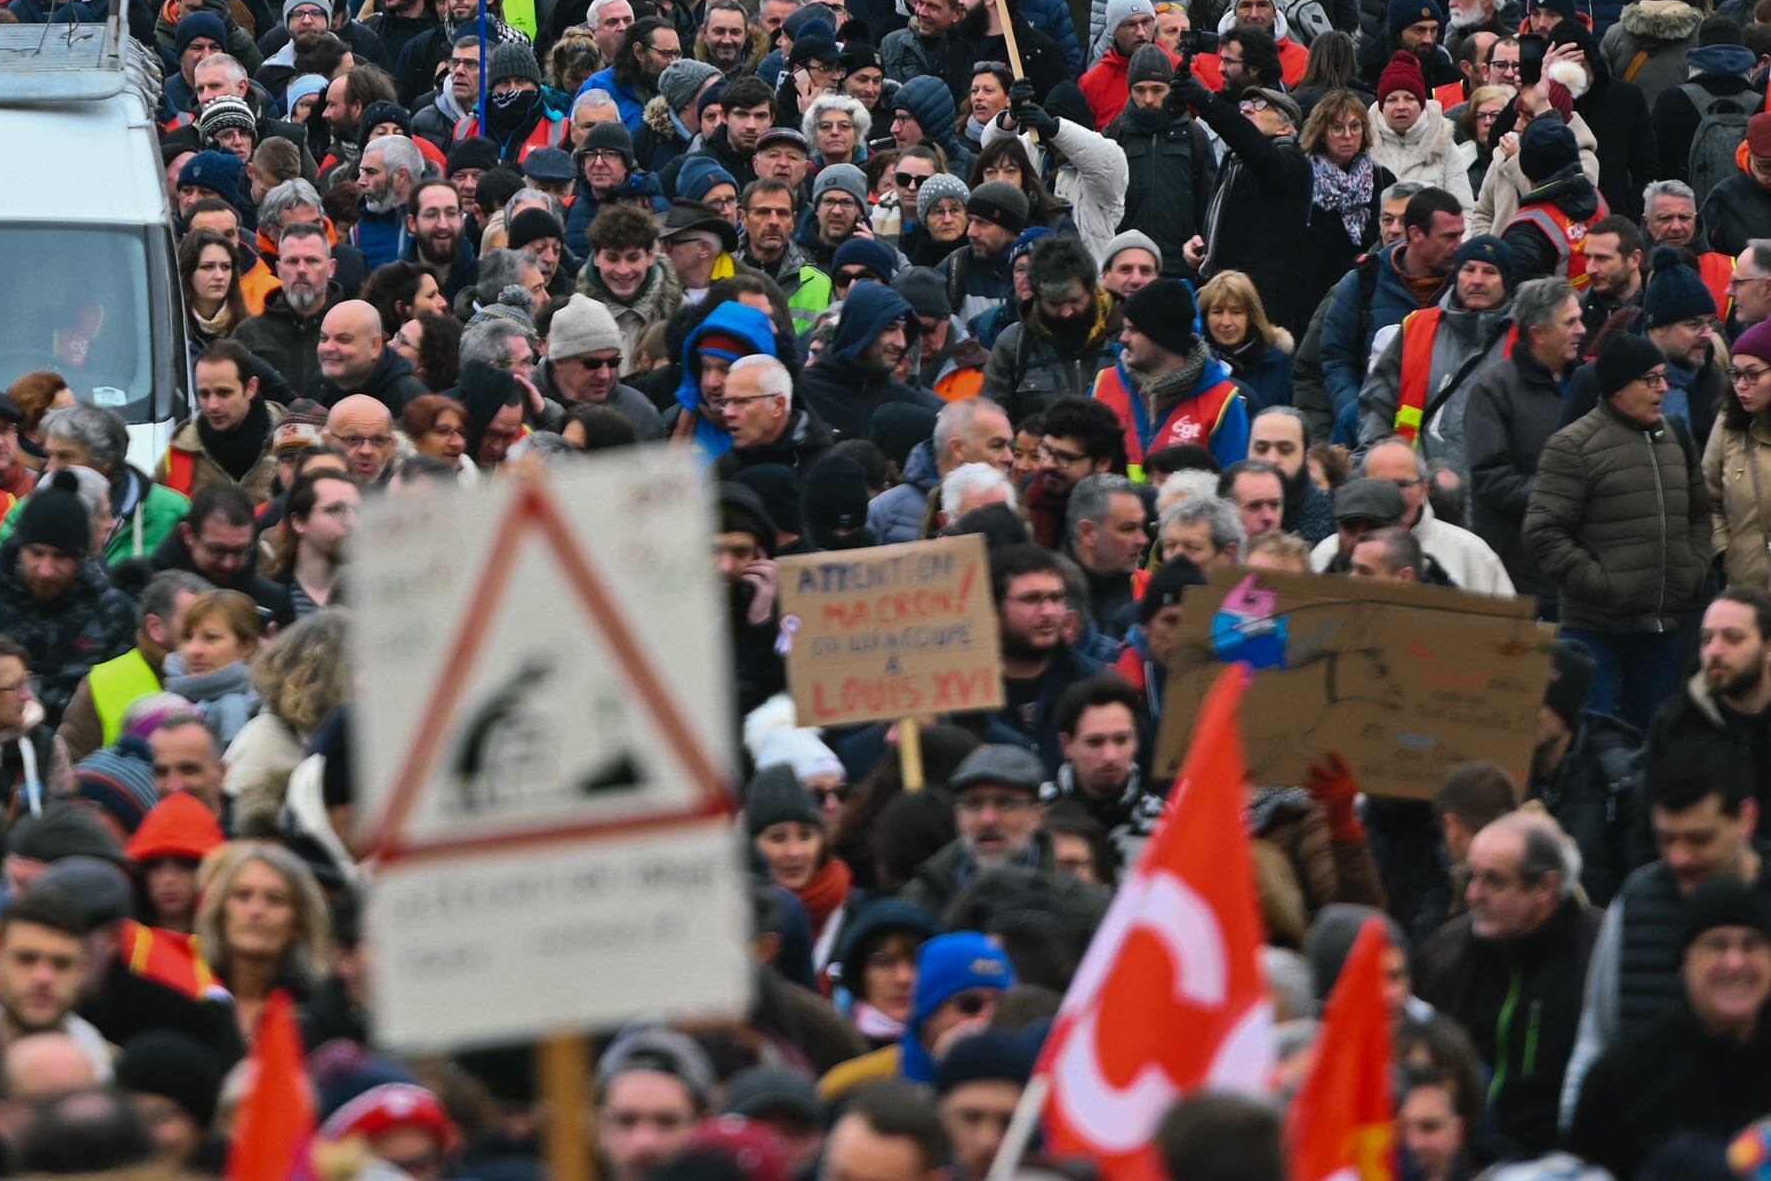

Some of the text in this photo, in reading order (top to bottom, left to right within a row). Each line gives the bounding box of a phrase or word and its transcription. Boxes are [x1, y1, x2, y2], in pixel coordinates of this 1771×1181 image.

[797, 552, 954, 595] ATTENTION
[812, 667, 994, 718] LOUIS XVI
